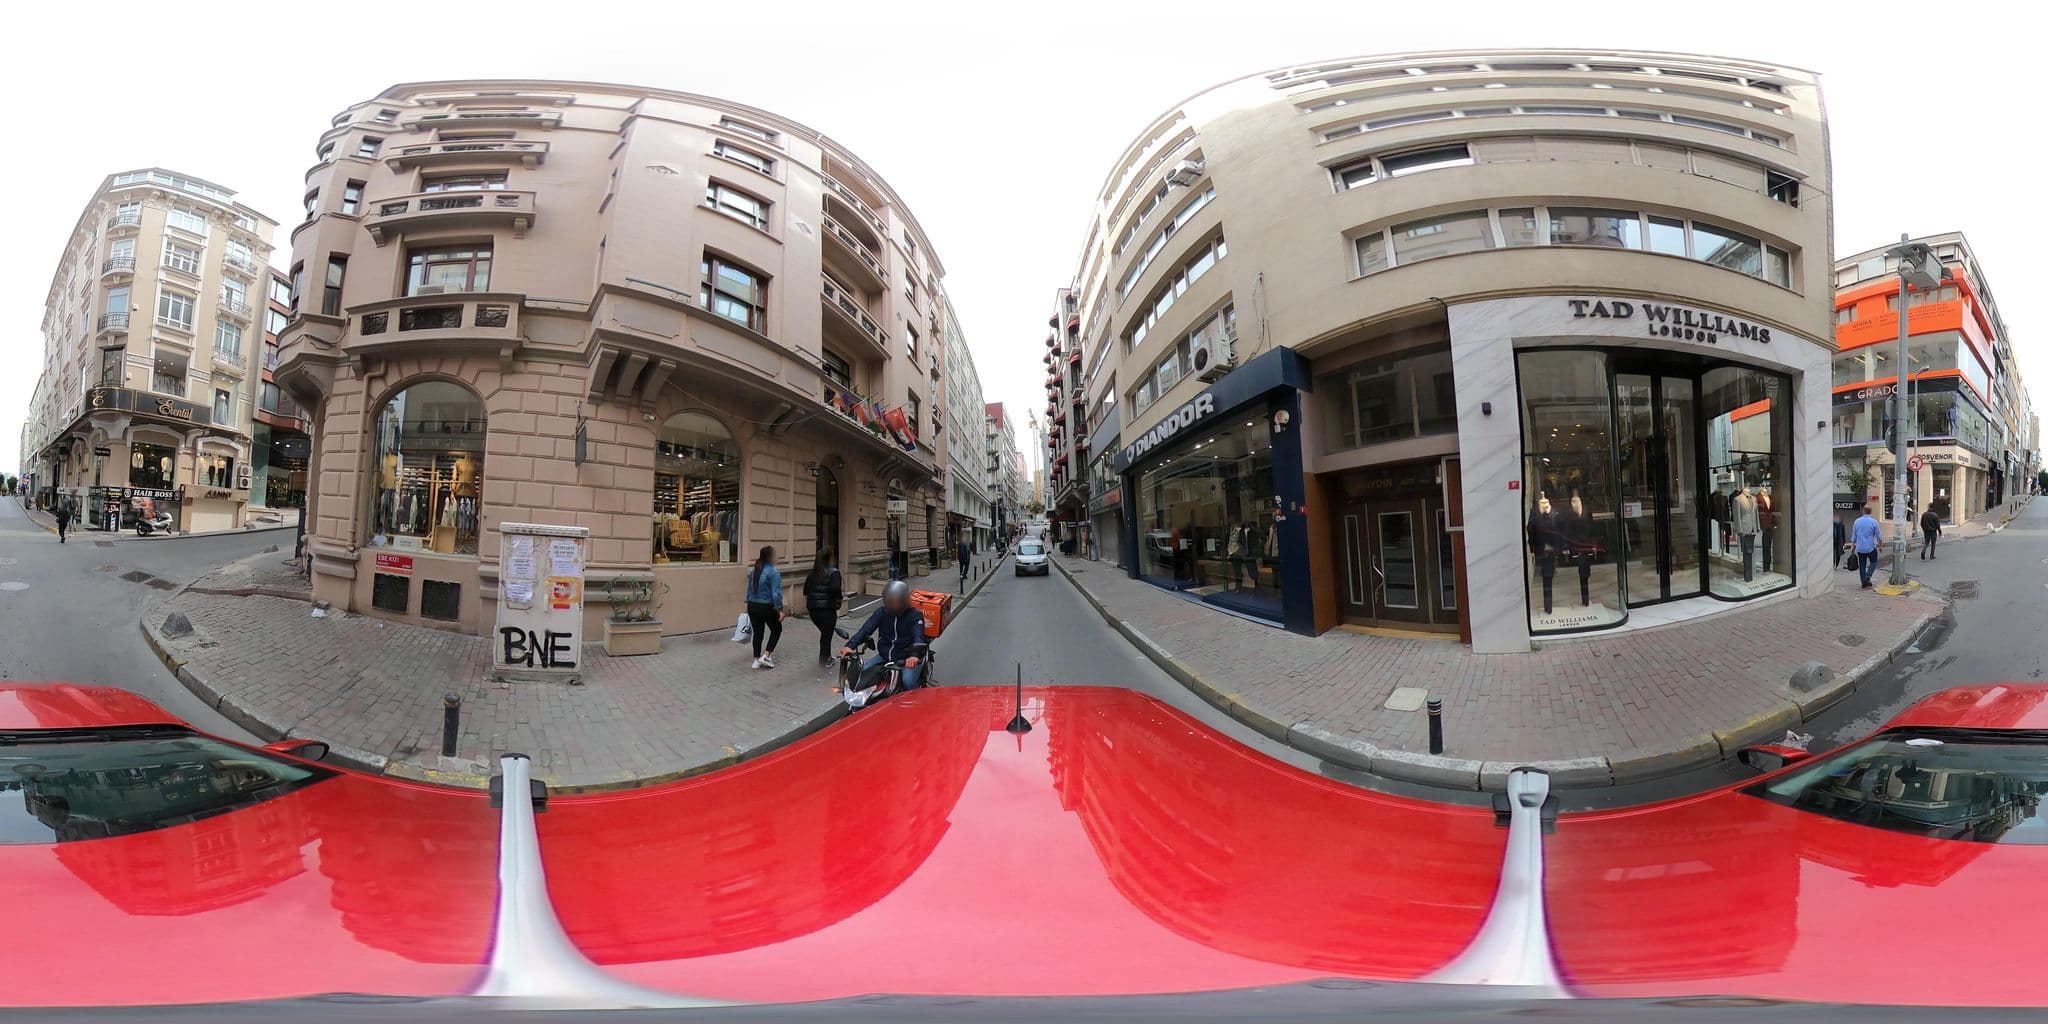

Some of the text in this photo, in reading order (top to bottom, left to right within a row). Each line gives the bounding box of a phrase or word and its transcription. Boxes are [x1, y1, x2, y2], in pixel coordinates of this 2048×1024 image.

[1568, 299, 1771, 344] TAD WILLIAMS
[1649, 323, 1717, 344] LONDON
[1136, 392, 1214, 457] DIANDOR
[1558, 615, 1598, 623] WILLIAMS
[500, 626, 576, 668] BNE
